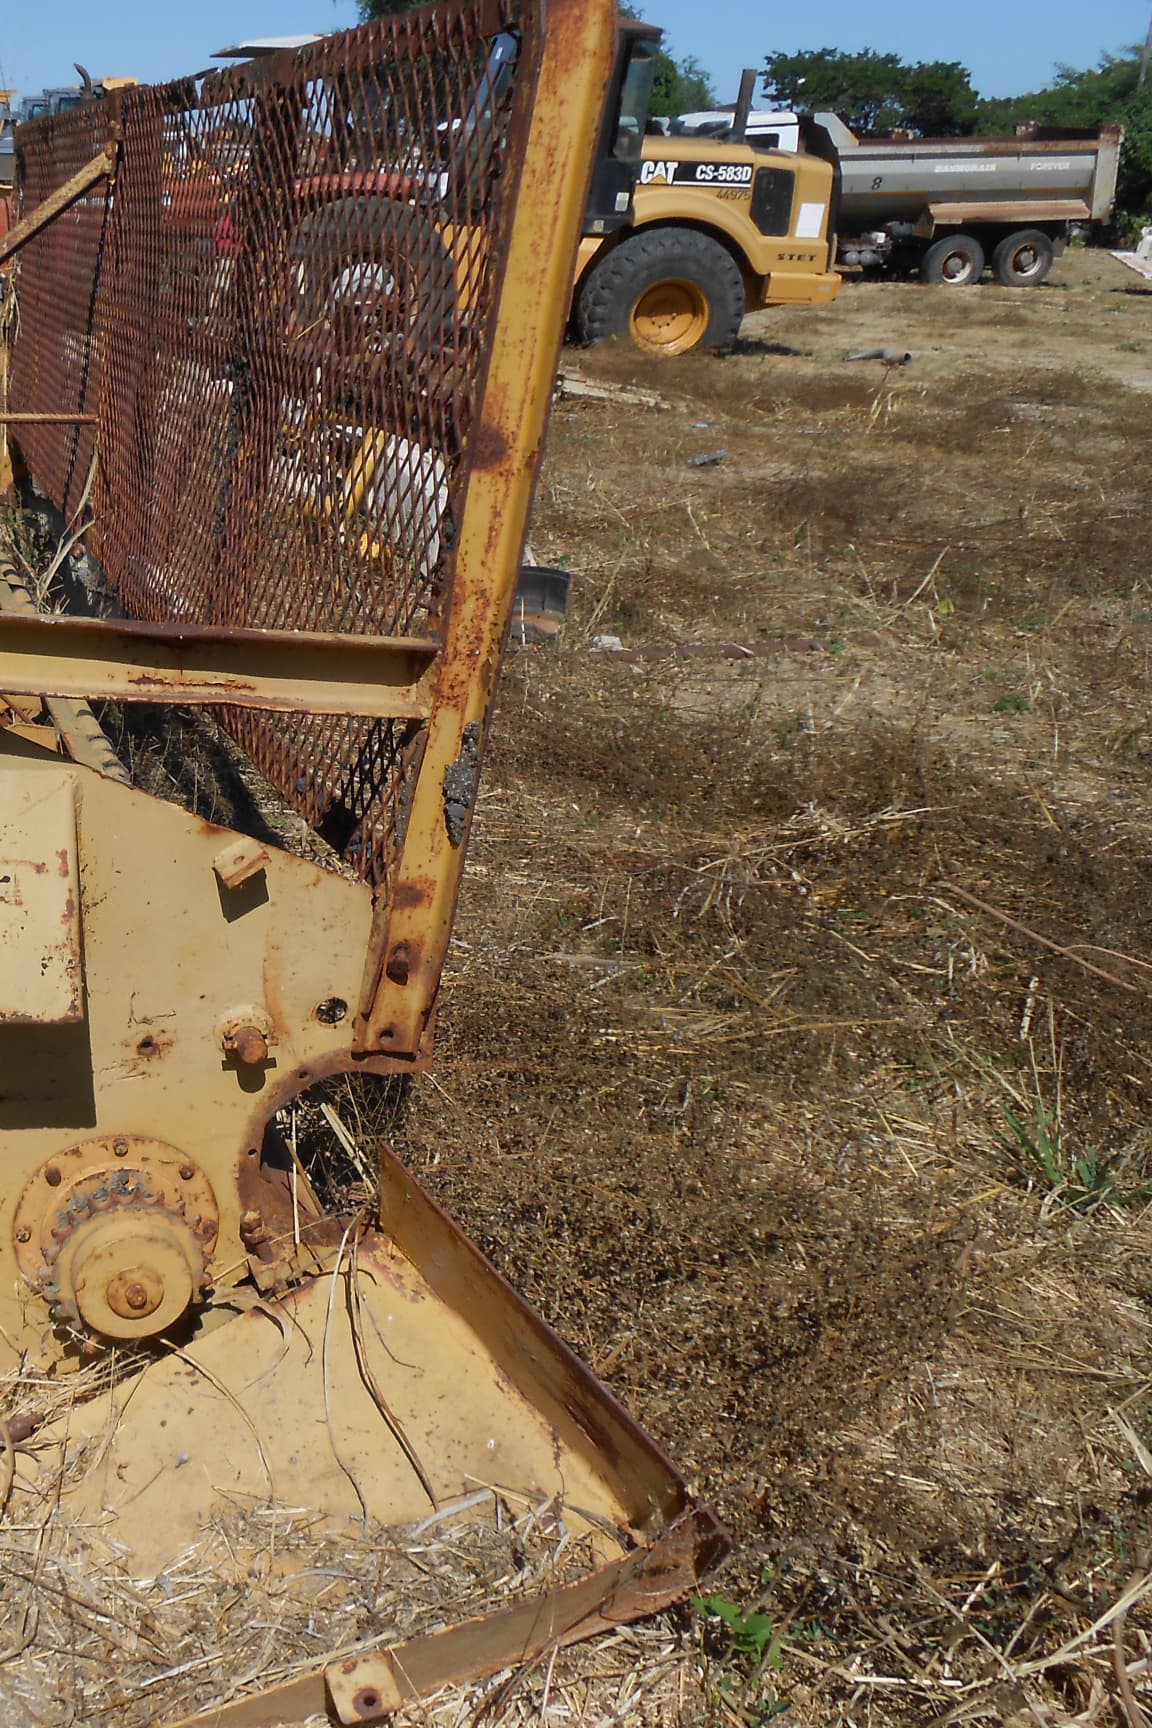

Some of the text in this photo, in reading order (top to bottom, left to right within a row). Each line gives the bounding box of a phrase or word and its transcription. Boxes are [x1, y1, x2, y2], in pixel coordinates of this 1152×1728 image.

[641, 161, 679, 185] CAT
[695, 165, 752, 181] CS-583D
[871, 176, 883, 190] 8
